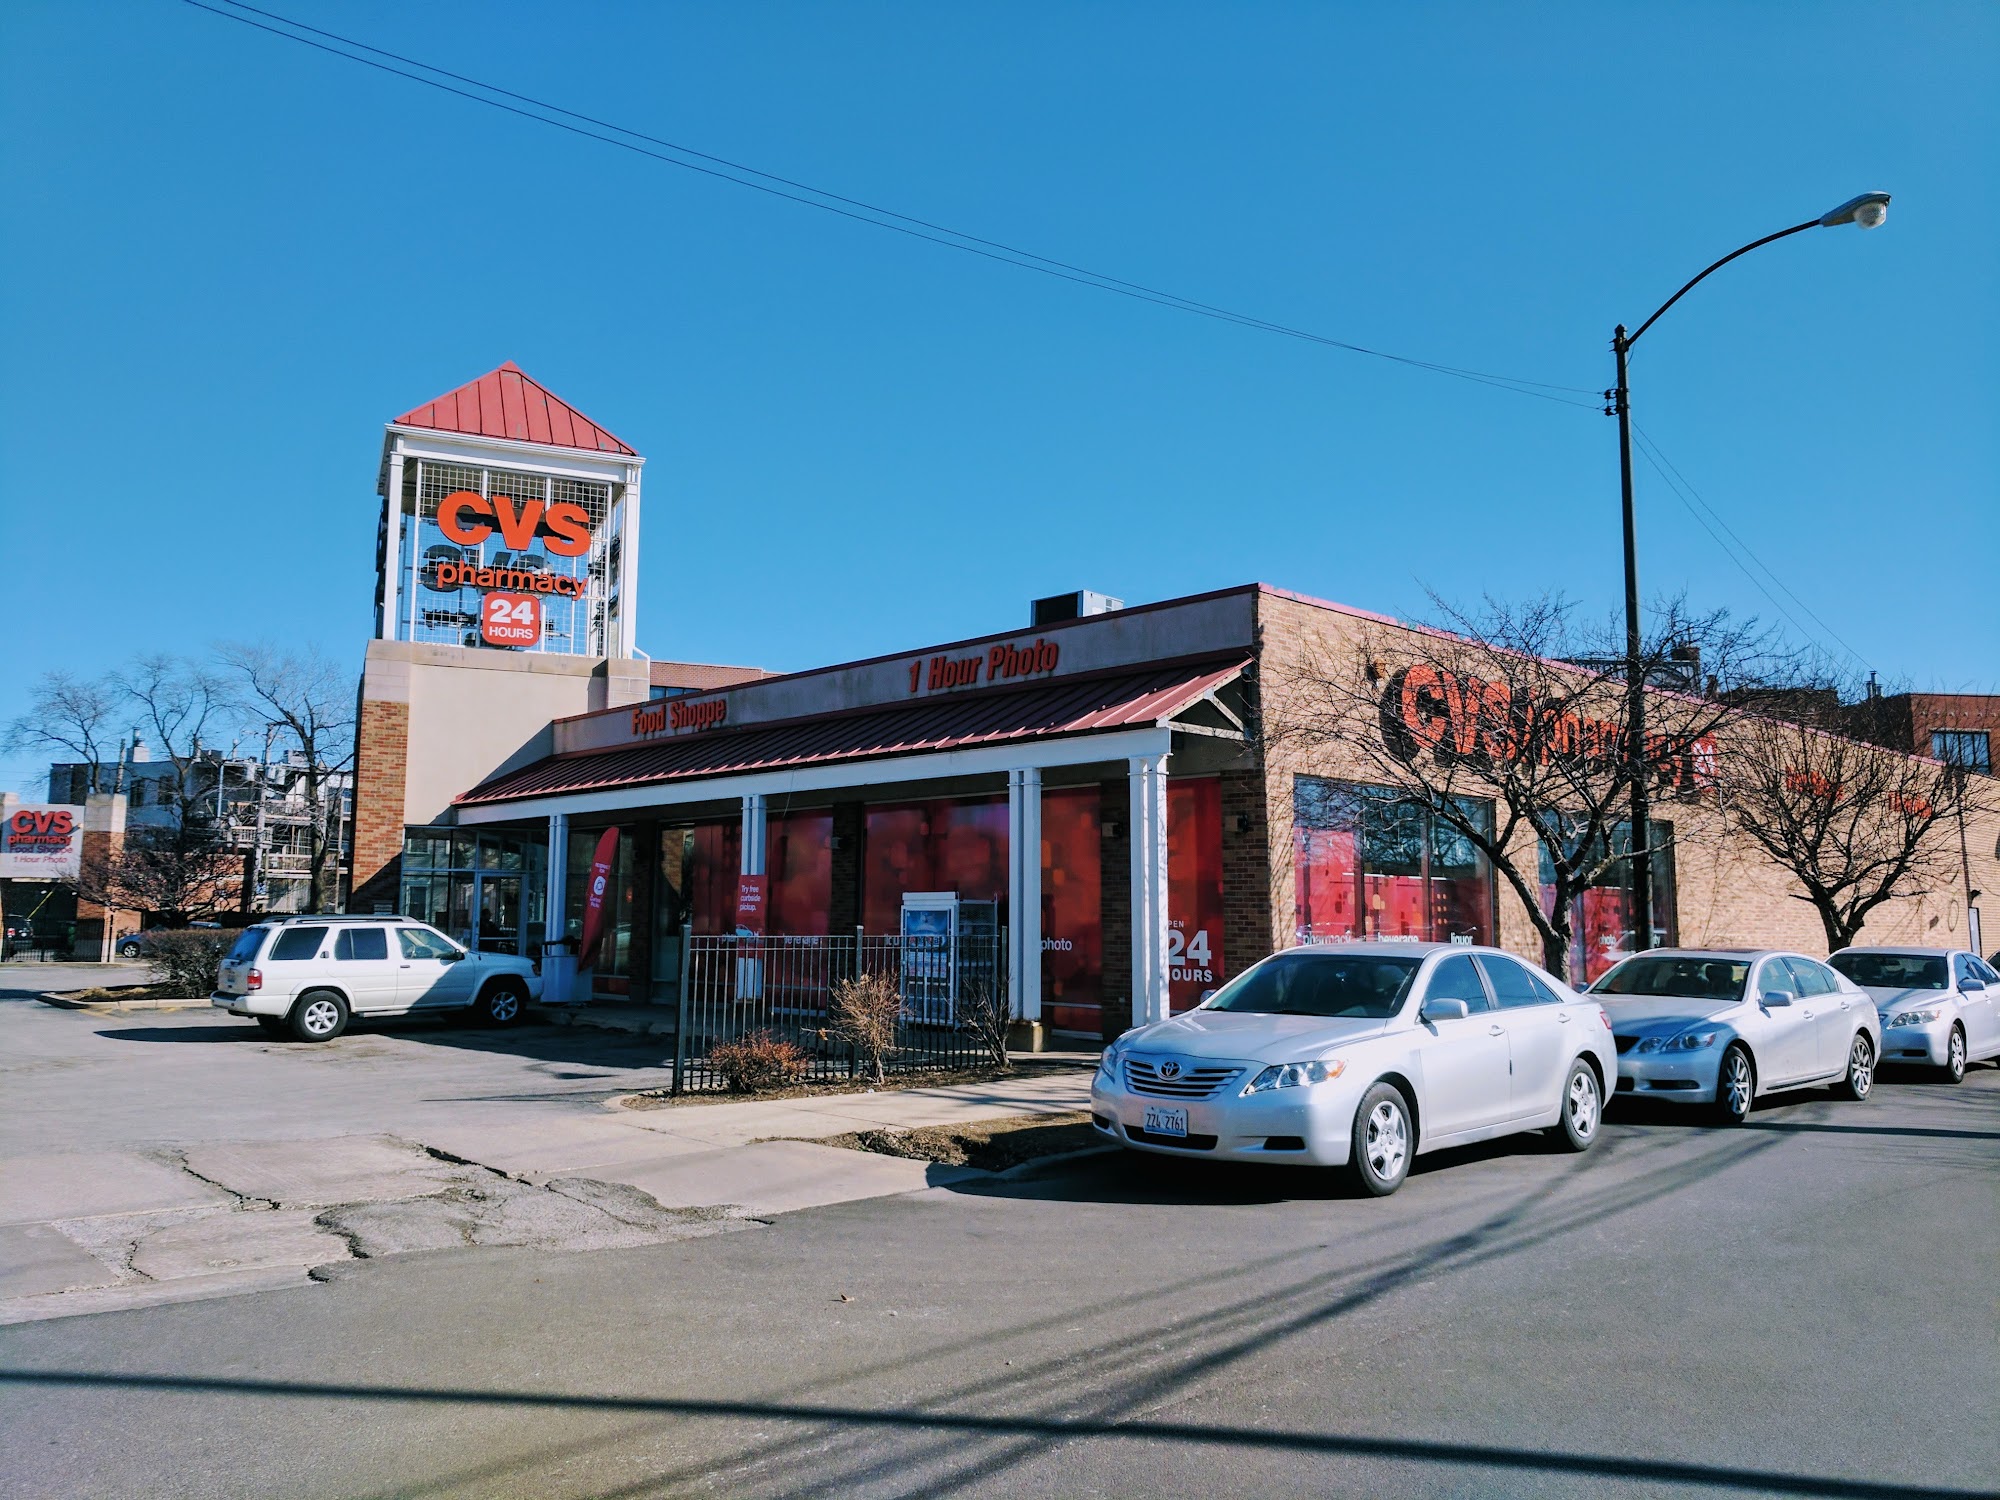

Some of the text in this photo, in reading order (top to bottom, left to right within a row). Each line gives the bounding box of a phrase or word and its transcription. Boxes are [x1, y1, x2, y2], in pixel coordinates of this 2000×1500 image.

[437, 489, 592, 557] CVS
[436, 559, 589, 601] pharmacy
[489, 598, 535, 625] 24
[488, 626, 534, 640] HOURS
[909, 638, 1059, 693] 1 Hour Photo
[632, 700, 728, 736] Food Shoppe
[11, 810, 73, 834] CVS
[8, 833, 72, 846] pharmacy
[10, 845, 73, 855] Food Shoppe
[43, 856, 68, 864] Photo
[1168, 920, 1185, 928] PEN
[1041, 936, 1073, 953] photo
[1168, 929, 1212, 967] 24
[1170, 967, 1213, 983] OURS
[1165, 1115, 1185, 1131] 2761
